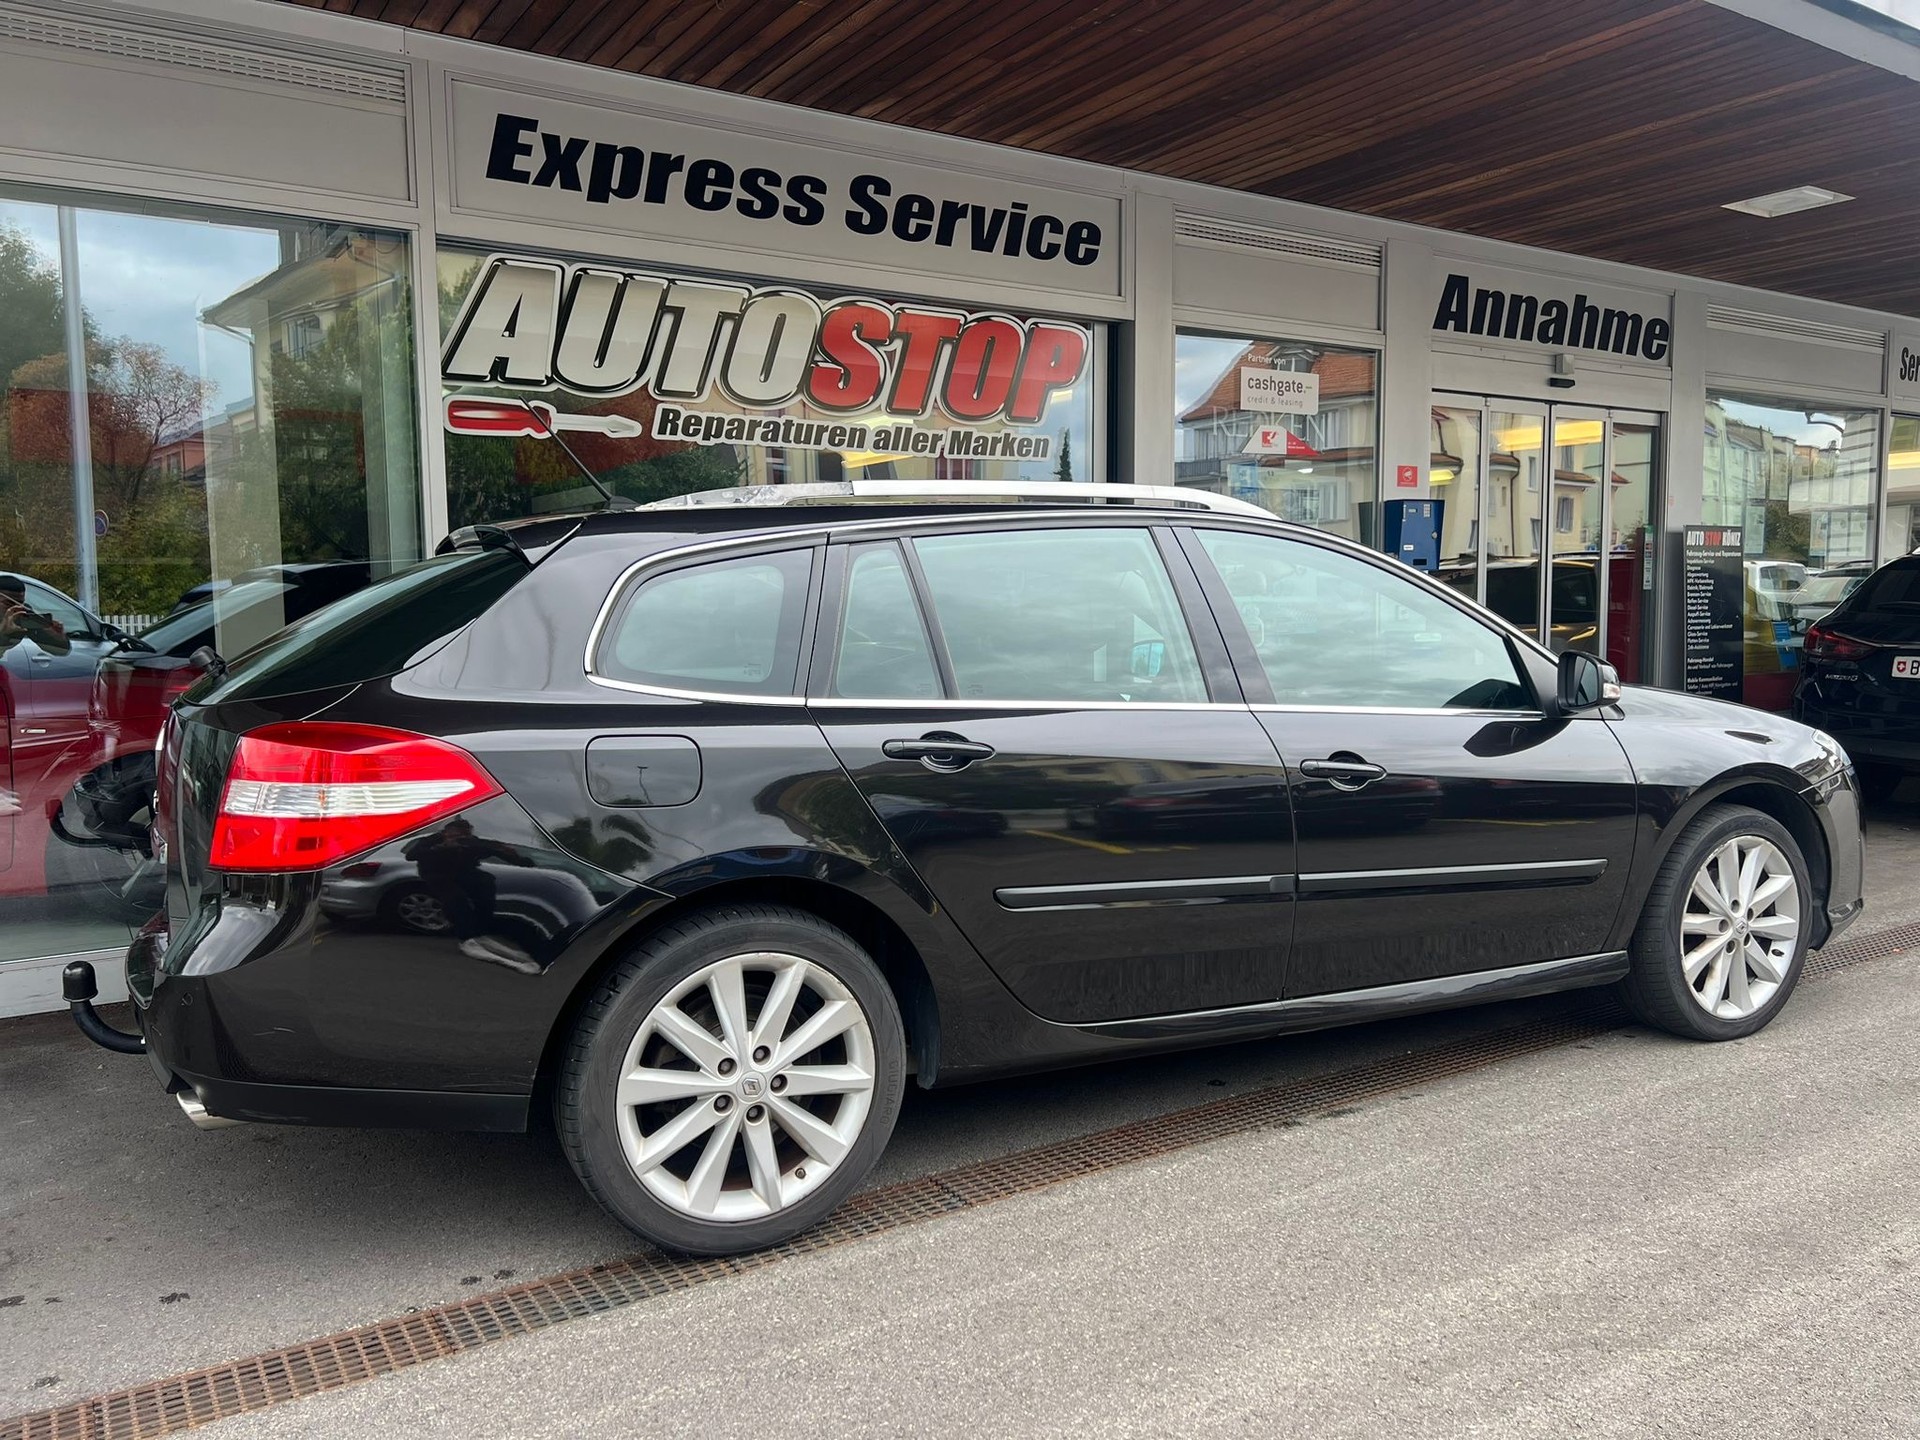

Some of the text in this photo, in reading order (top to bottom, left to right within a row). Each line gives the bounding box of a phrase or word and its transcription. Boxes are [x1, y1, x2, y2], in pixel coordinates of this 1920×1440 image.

[486, 113, 1102, 266] Express Service
[1432, 273, 1670, 360] Annahme
[1247, 353, 1286, 366] Partner von
[1247, 396, 1268, 404] credit
[1278, 397, 1304, 408] leasing
[657, 406, 1052, 459] Reparaturen aller Marken
[1686, 530, 1703, 545] AUTO
[1704, 530, 1721, 545] STOP
